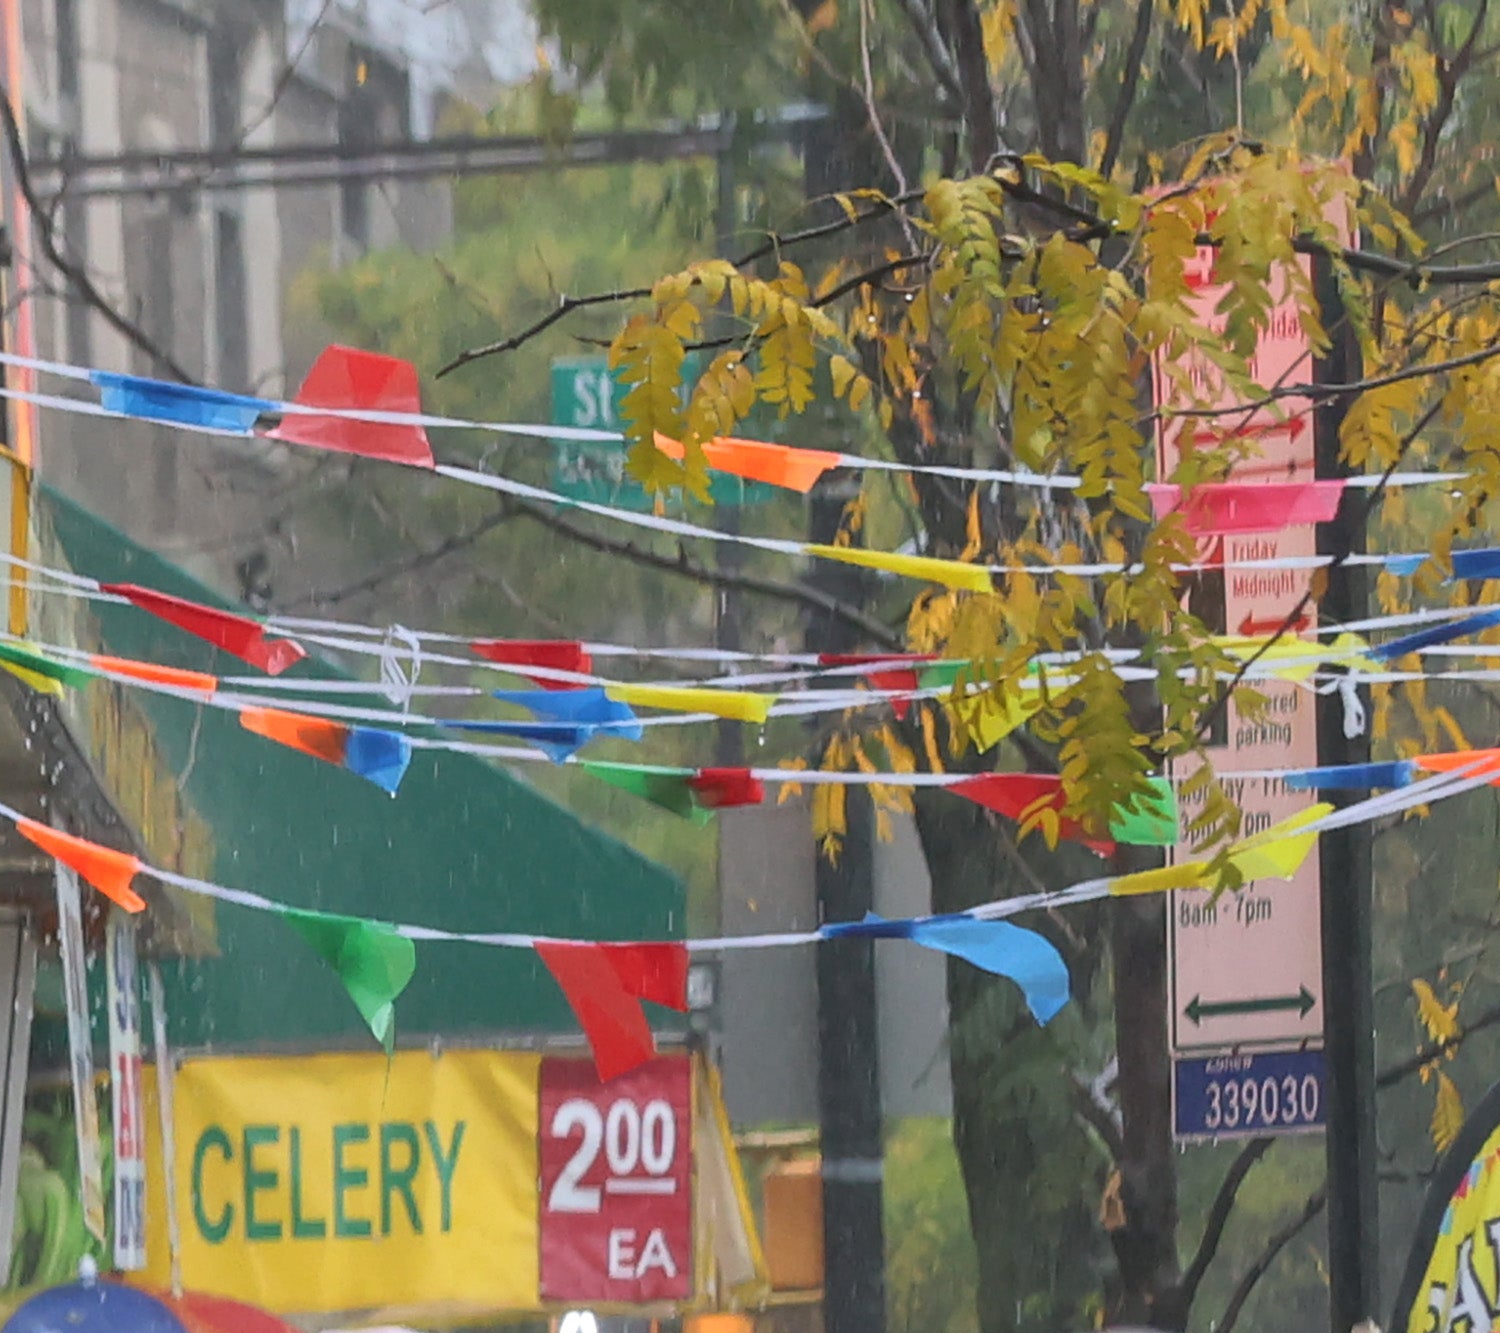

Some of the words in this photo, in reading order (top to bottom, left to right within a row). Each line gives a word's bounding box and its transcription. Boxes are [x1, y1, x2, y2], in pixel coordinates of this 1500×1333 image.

[1233, 572, 1295, 599] Midnight
[1235, 720, 1292, 750] parking
[1236, 893, 1272, 928] 7pm
[1204, 1073, 1319, 1129] 339030
[191, 1119, 467, 1245] CELERY
[607, 1229, 676, 1280] EA
